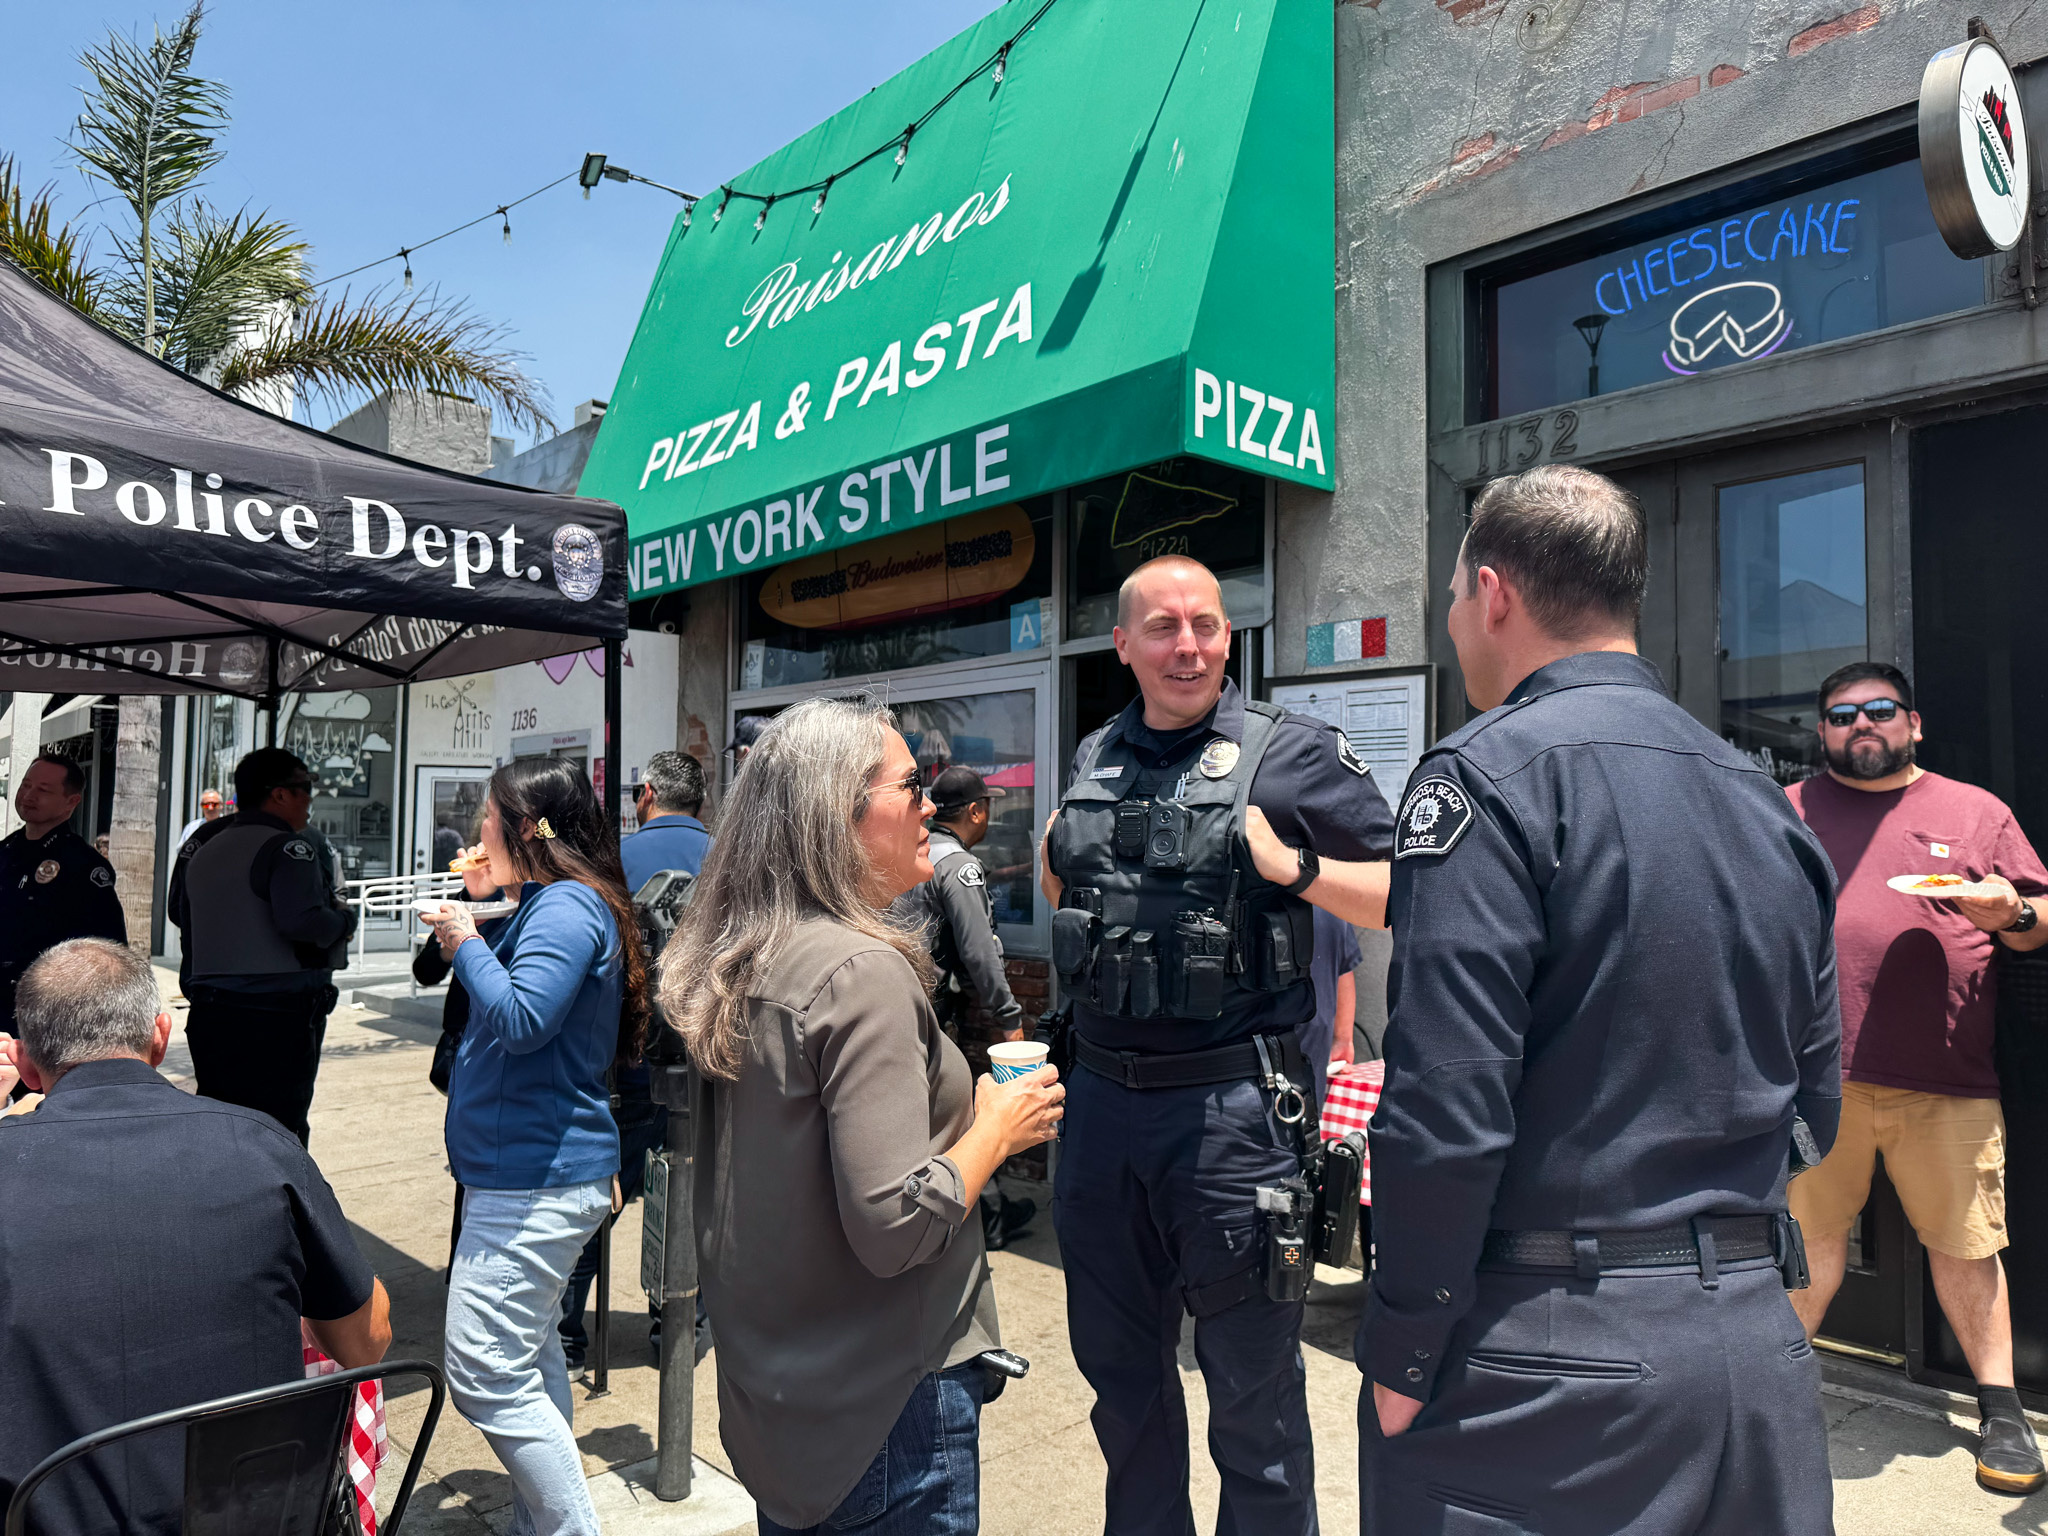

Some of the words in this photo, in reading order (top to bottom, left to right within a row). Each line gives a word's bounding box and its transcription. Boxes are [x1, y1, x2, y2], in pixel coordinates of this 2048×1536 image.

[725, 172, 1014, 348] Paisanos
[1595, 199, 1861, 315] CHEESECAKE
[638, 400, 761, 490] PIZZA
[774, 381, 812, 440] &
[823, 281, 1033, 422] PASTA
[1194, 367, 1326, 475] PIZZA
[1477, 408, 1579, 476] 1132
[41, 448, 319, 549] Police
[344, 496, 543, 590] Dept.
[627, 528, 697, 593] NEW
[707, 492, 826, 572] YORK
[838, 423, 1010, 533] STYLE
[846, 550, 945, 590] Budweiser
[1138, 535, 1190, 560] PIZZA
[1017, 613, 1036, 644] A
[511, 707, 537, 732] 1136
[1435, 784, 1464, 813] BEACH
[1403, 834, 1437, 850] POLICE
